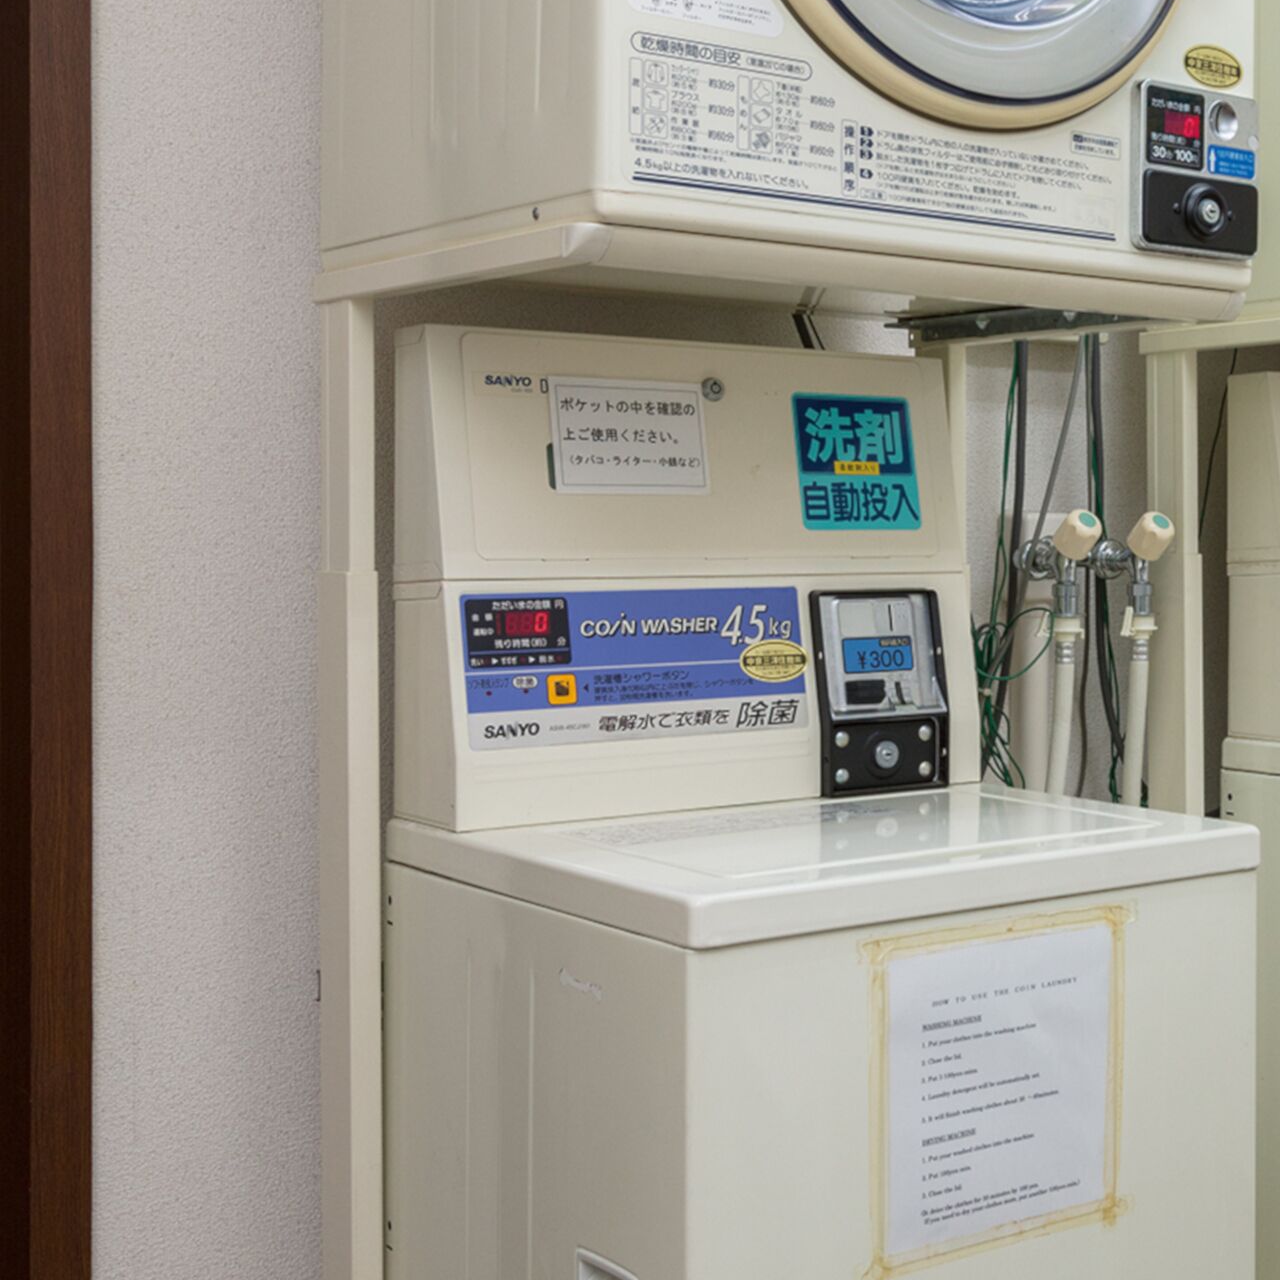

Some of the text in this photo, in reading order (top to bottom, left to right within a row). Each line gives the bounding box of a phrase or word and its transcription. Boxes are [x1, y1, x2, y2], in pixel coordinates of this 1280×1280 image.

[640, 37, 741, 66] 乾燥時間の目安
[484, 374, 532, 387] SANYO
[559, 397, 696, 417] ポケットの中を確認の
[563, 427, 680, 445] 上ご使用ください。
[804, 407, 904, 465] 洗剤
[803, 481, 919, 522] 自動投入
[534, 611, 549, 632] 0
[641, 617, 717, 635] WASHER
[857, 650, 904, 669] ¥300
[598, 699, 799, 732] 電解水で衣類を 除菌
[483, 722, 540, 739] SANYO
[955, 995, 966, 1004] TO
